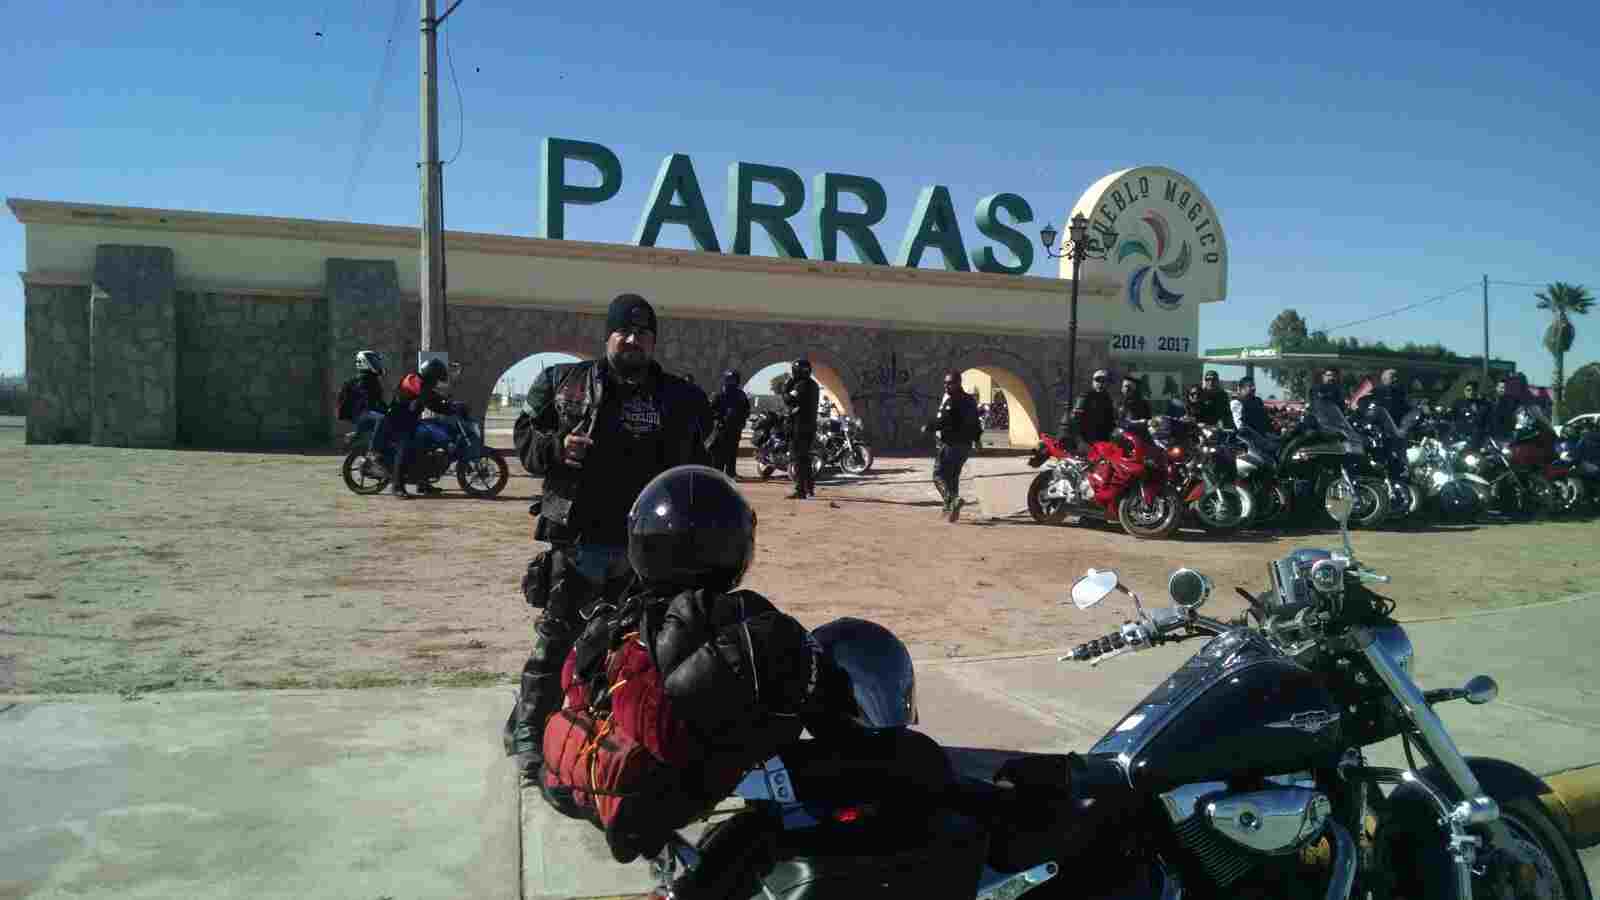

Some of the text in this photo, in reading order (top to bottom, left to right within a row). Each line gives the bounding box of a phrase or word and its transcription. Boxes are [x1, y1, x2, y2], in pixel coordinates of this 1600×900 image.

[540, 136, 1034, 275] PARRAS
[1087, 175, 1150, 252] PUEBLO
[1111, 334, 1190, 352] 2014 2017
